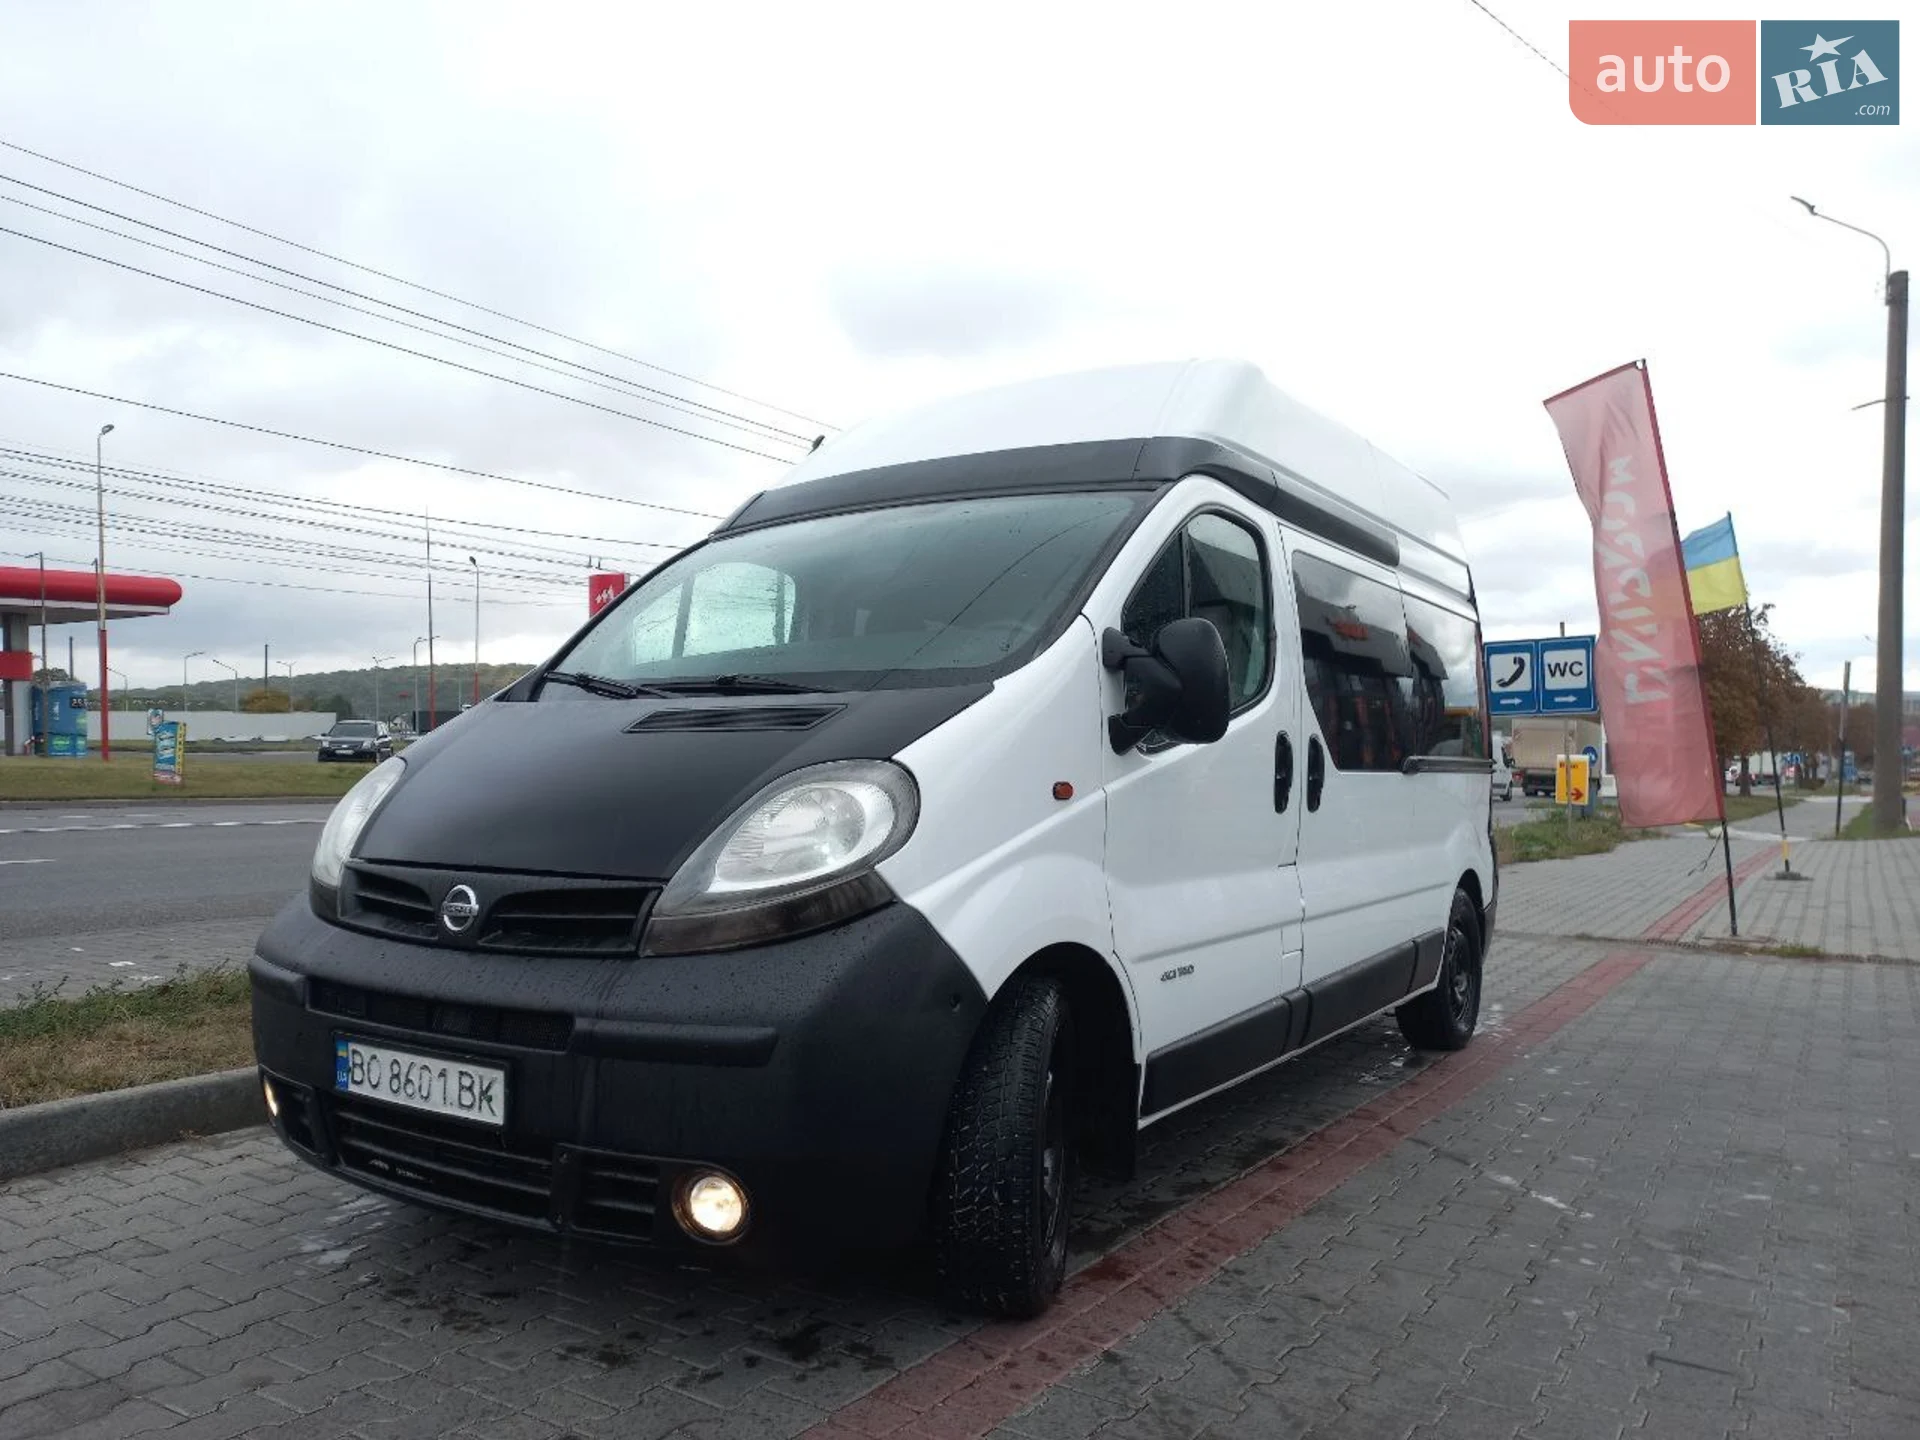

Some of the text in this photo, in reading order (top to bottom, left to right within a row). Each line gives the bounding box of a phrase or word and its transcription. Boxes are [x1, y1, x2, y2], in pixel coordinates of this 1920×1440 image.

[1547, 660, 1584, 679] WC
[389, 1058, 446, 1106] 8601
[458, 1070, 498, 1117] BK
